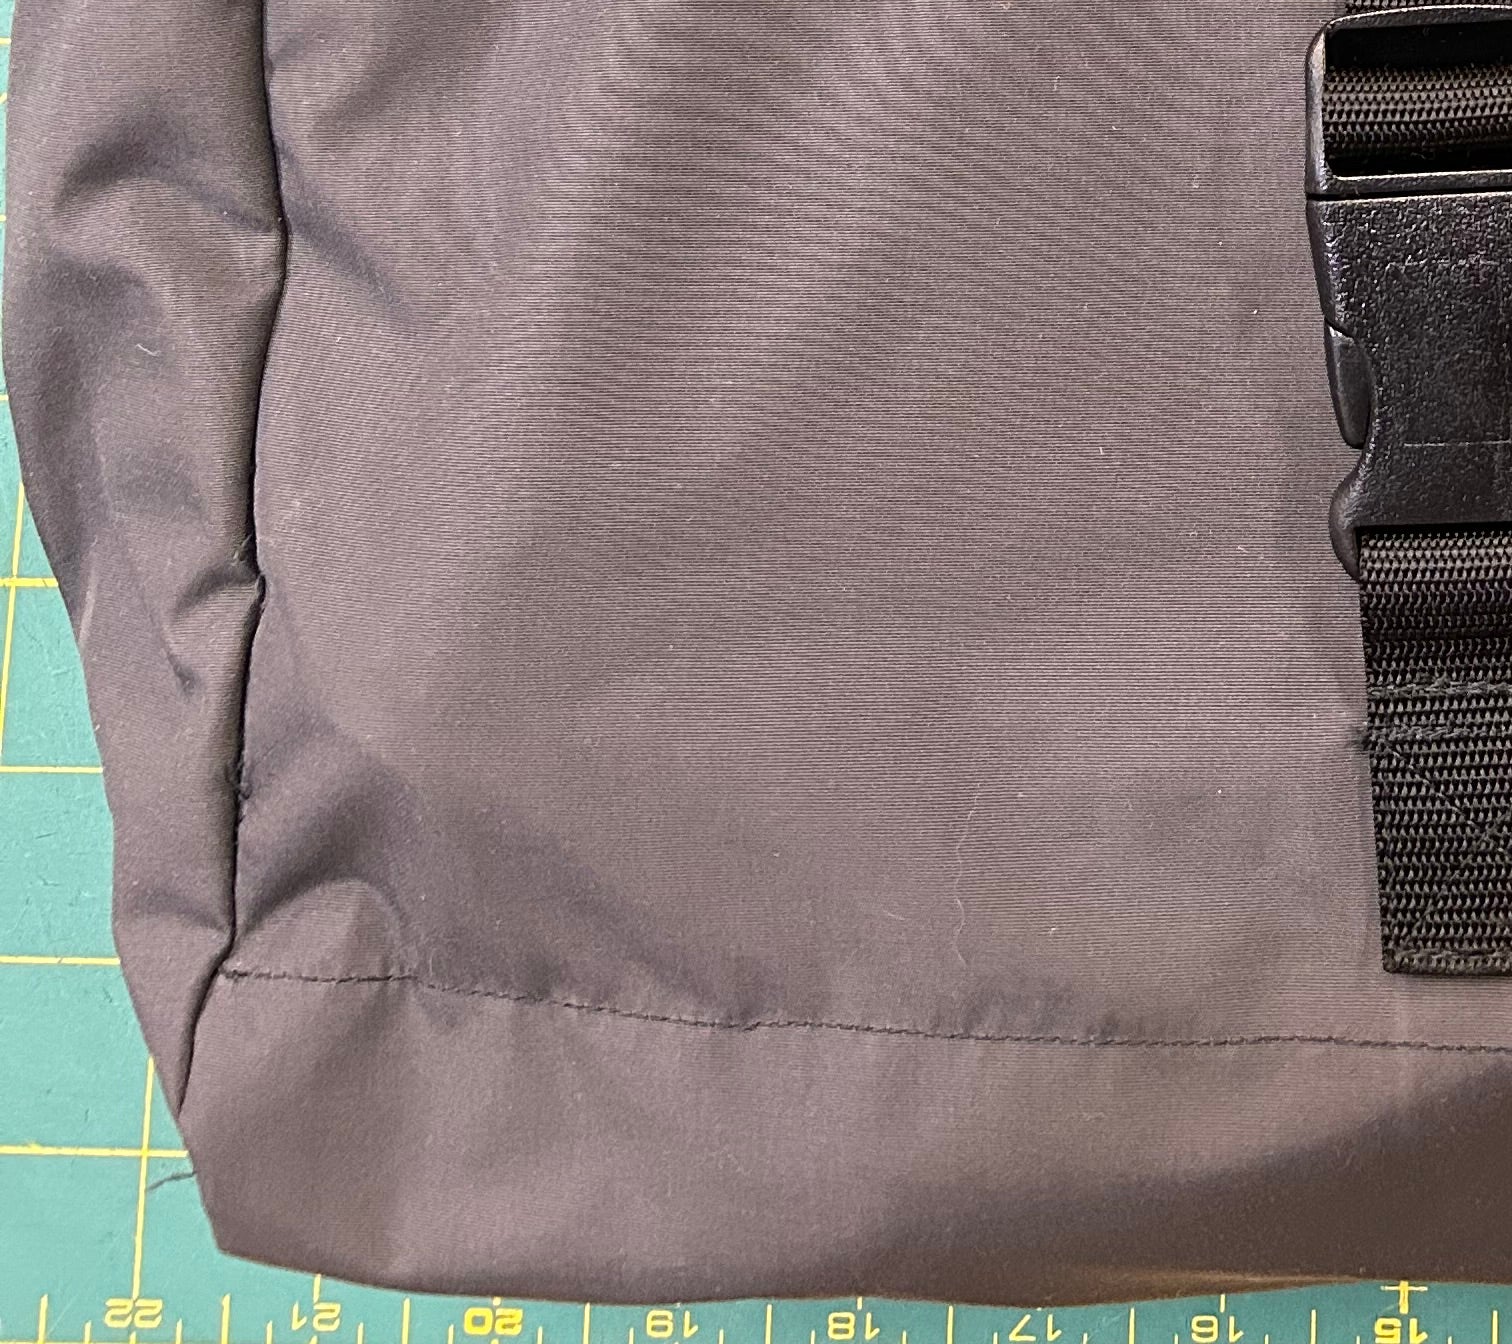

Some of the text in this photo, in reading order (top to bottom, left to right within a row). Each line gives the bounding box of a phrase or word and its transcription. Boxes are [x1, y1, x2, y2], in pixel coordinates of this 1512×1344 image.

[104, 1298, 163, 1329] 22
[291, 1300, 341, 1332] 21
[463, 1307, 523, 1336] 20
[646, 1310, 698, 1338] 19
[828, 1312, 880, 1340] 18
[1008, 1313, 1062, 1342] 17
[1191, 1315, 1244, 1343] 16
